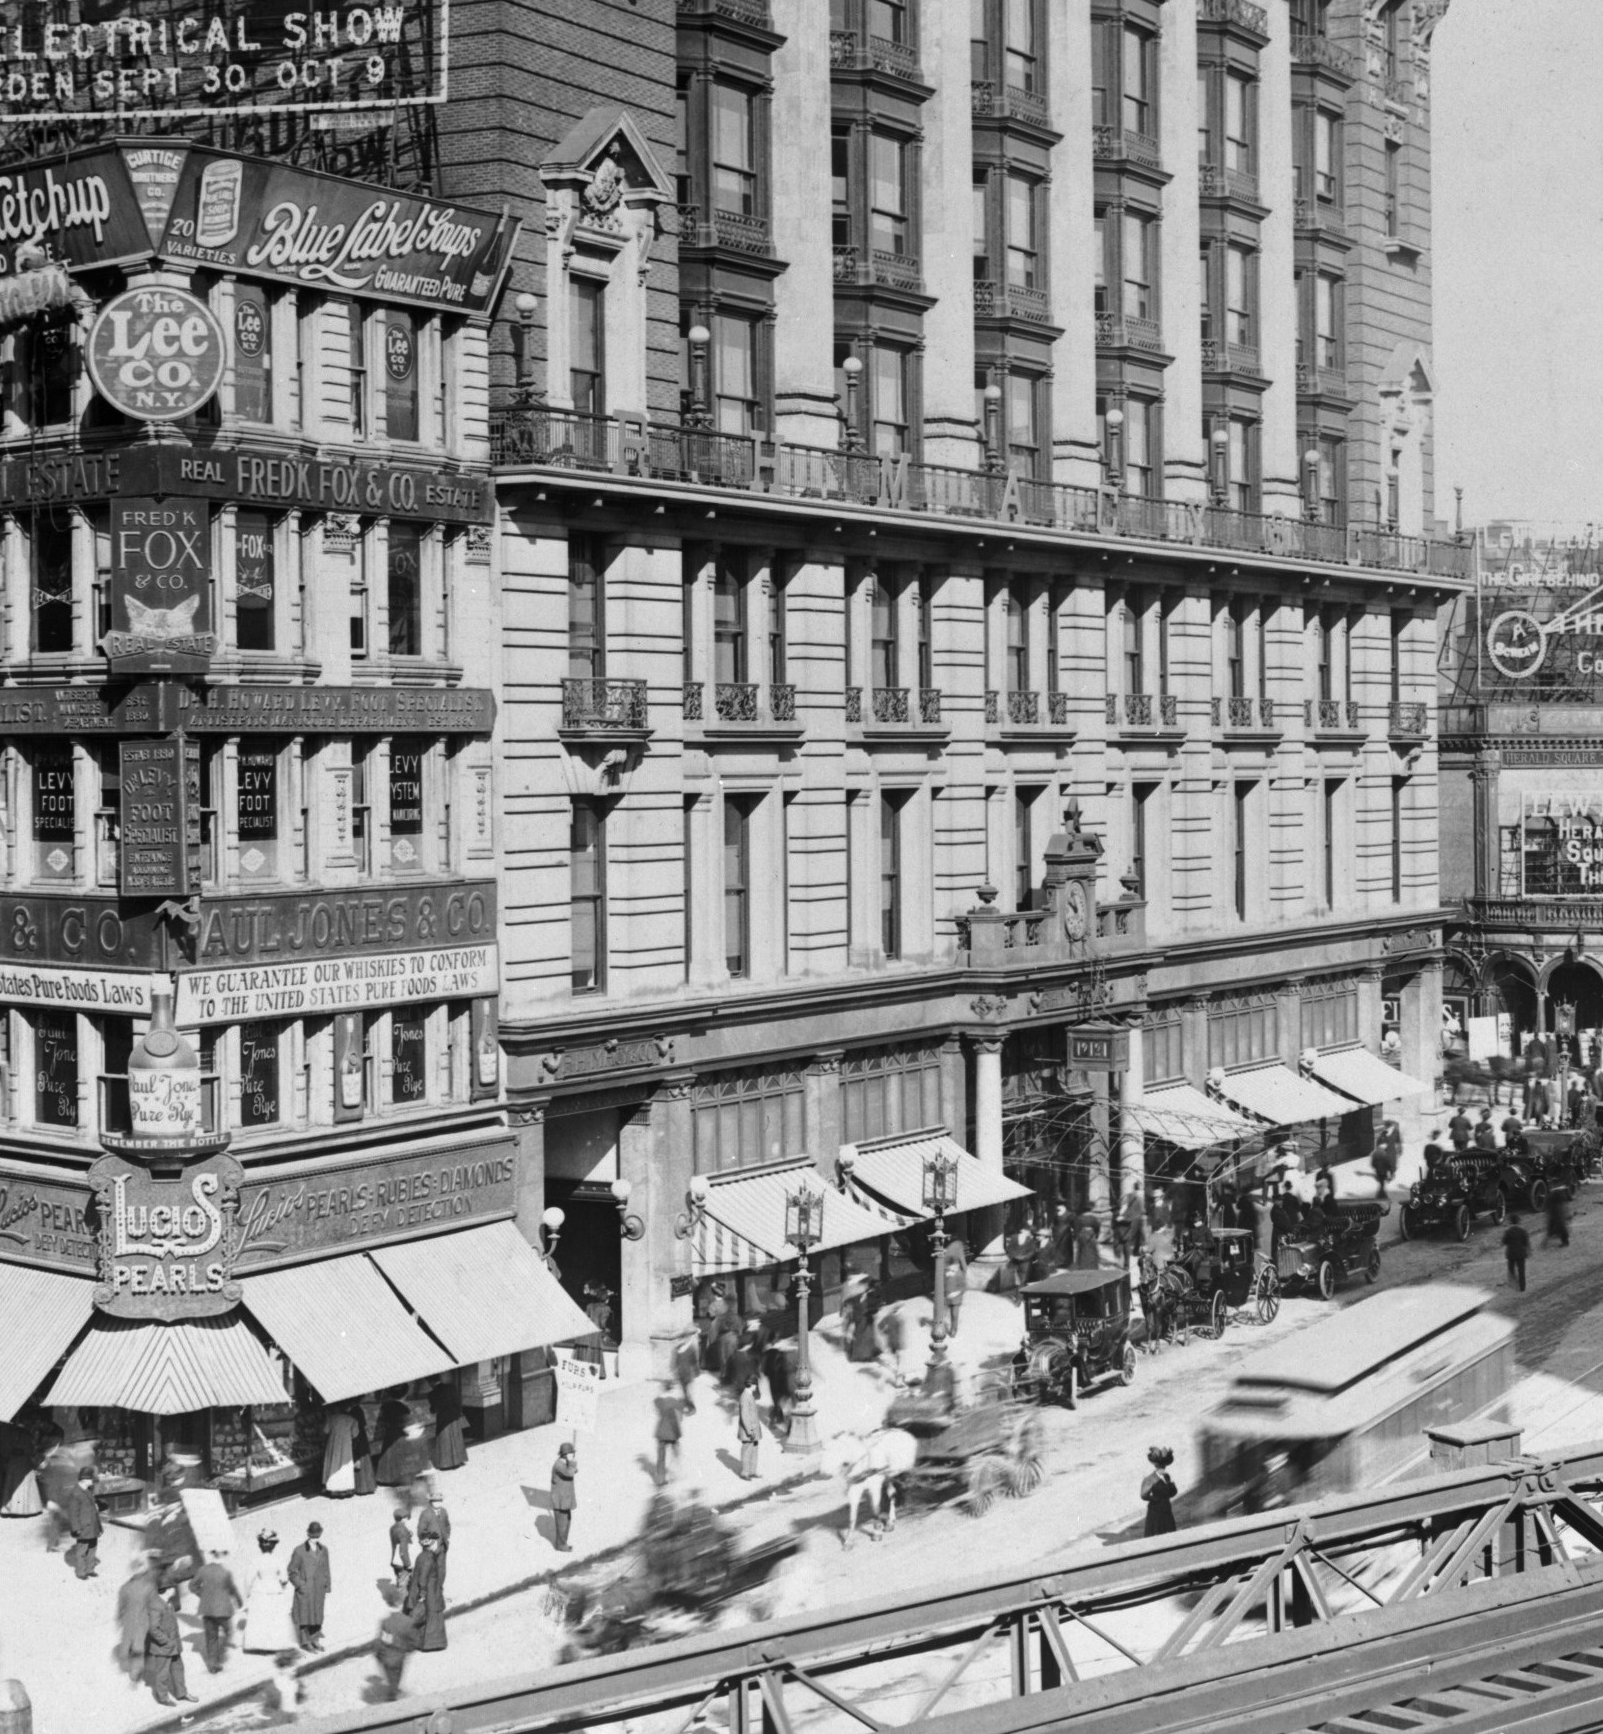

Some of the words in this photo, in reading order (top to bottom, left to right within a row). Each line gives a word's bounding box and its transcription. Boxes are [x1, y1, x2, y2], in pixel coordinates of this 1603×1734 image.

[283, 6, 405, 50] SHOW
[96, 69, 181, 100] SEPT
[202, 63, 246, 94] 30
[277, 58, 343, 90] OCT
[366, 56, 386, 86] 9
[169, 218, 194, 237] 20
[167, 240, 236, 265] VARIETIES
[247, 202, 345, 266] Blue
[299, 201, 431, 289] Label
[416, 208, 481, 271] Soups
[374, 264, 440, 298] GUARANTEED
[439, 276, 467, 302] PURE
[133, 293, 185, 313] The
[237, 312, 261, 332] Lee
[108, 311, 209, 360] Lee
[388, 337, 409, 355] Lee
[135, 392, 185, 407] N.Y.
[25, 453, 121, 502] ESTATE
[181, 458, 225, 483] REAL
[237, 456, 311, 501] FRED'K
[319, 466, 360, 507] FOX
[366, 471, 383, 507] &
[389, 472, 419, 511] CO.
[426, 484, 480, 511] ESTATE
[122, 511, 197, 526] FRED'K
[118, 530, 204, 570] FOX
[241, 534, 264, 559] FOX
[135, 574, 151, 589] &
[156, 574, 188, 589] CO.
[1512, 623, 1527, 641] A
[112, 636, 155, 655] REAL
[166, 636, 213, 654] ESTATE
[228, 690, 295, 711] HOWARD
[351, 691, 388, 713] FOOT
[1506, 753, 1549, 764] HERALD
[1554, 753, 1597, 764] SQUARE
[42, 795, 74, 811] FOOT
[130, 803, 173, 823] FOOT
[240, 796, 270, 811] FOOT
[1559, 818, 1603, 840] HERA
[12, 905, 37, 952] &
[61, 908, 136, 958] CO.
[289, 896, 408, 950] JONES
[416, 896, 437, 940] &
[448, 891, 490, 937] CO.
[189, 975, 211, 996] WE
[217, 967, 308, 993] GUARANTEE
[314, 963, 340, 984] OUR
[345, 957, 406, 981] WHISKIES
[410, 955, 426, 974] TO
[429, 949, 487, 973] CONFORM
[32, 977, 62, 1001] Pure
[63, 976, 98, 1003] Foods
[101, 979, 143, 1007] Laws
[199, 999, 215, 1019] TO
[221, 995, 249, 1017] THE
[255, 990, 304, 1013] UNITED
[310, 984, 360, 1007] STATES
[365, 981, 396, 1002] PURE
[401, 976, 437, 998] FOODS
[443, 972, 478, 992] LAWS
[393, 1023, 424, 1056] Jones
[243, 1042, 276, 1078] Jones
[38, 1070, 65, 1093] Pure
[403, 1074, 423, 1098] Rye
[253, 1093, 276, 1121] Rye
[102, 1136, 158, 1149] REMEMBER
[163, 1139, 187, 1148] THE
[190, 1135, 226, 1146] BOTTLE
[440, 1157, 514, 1196] DIAMONDS
[350, 1209, 390, 1237] DEFY
[397, 1195, 473, 1228] DETECTION
[35, 1233, 58, 1254] DEFY
[113, 1263, 224, 1296] PEARLS
